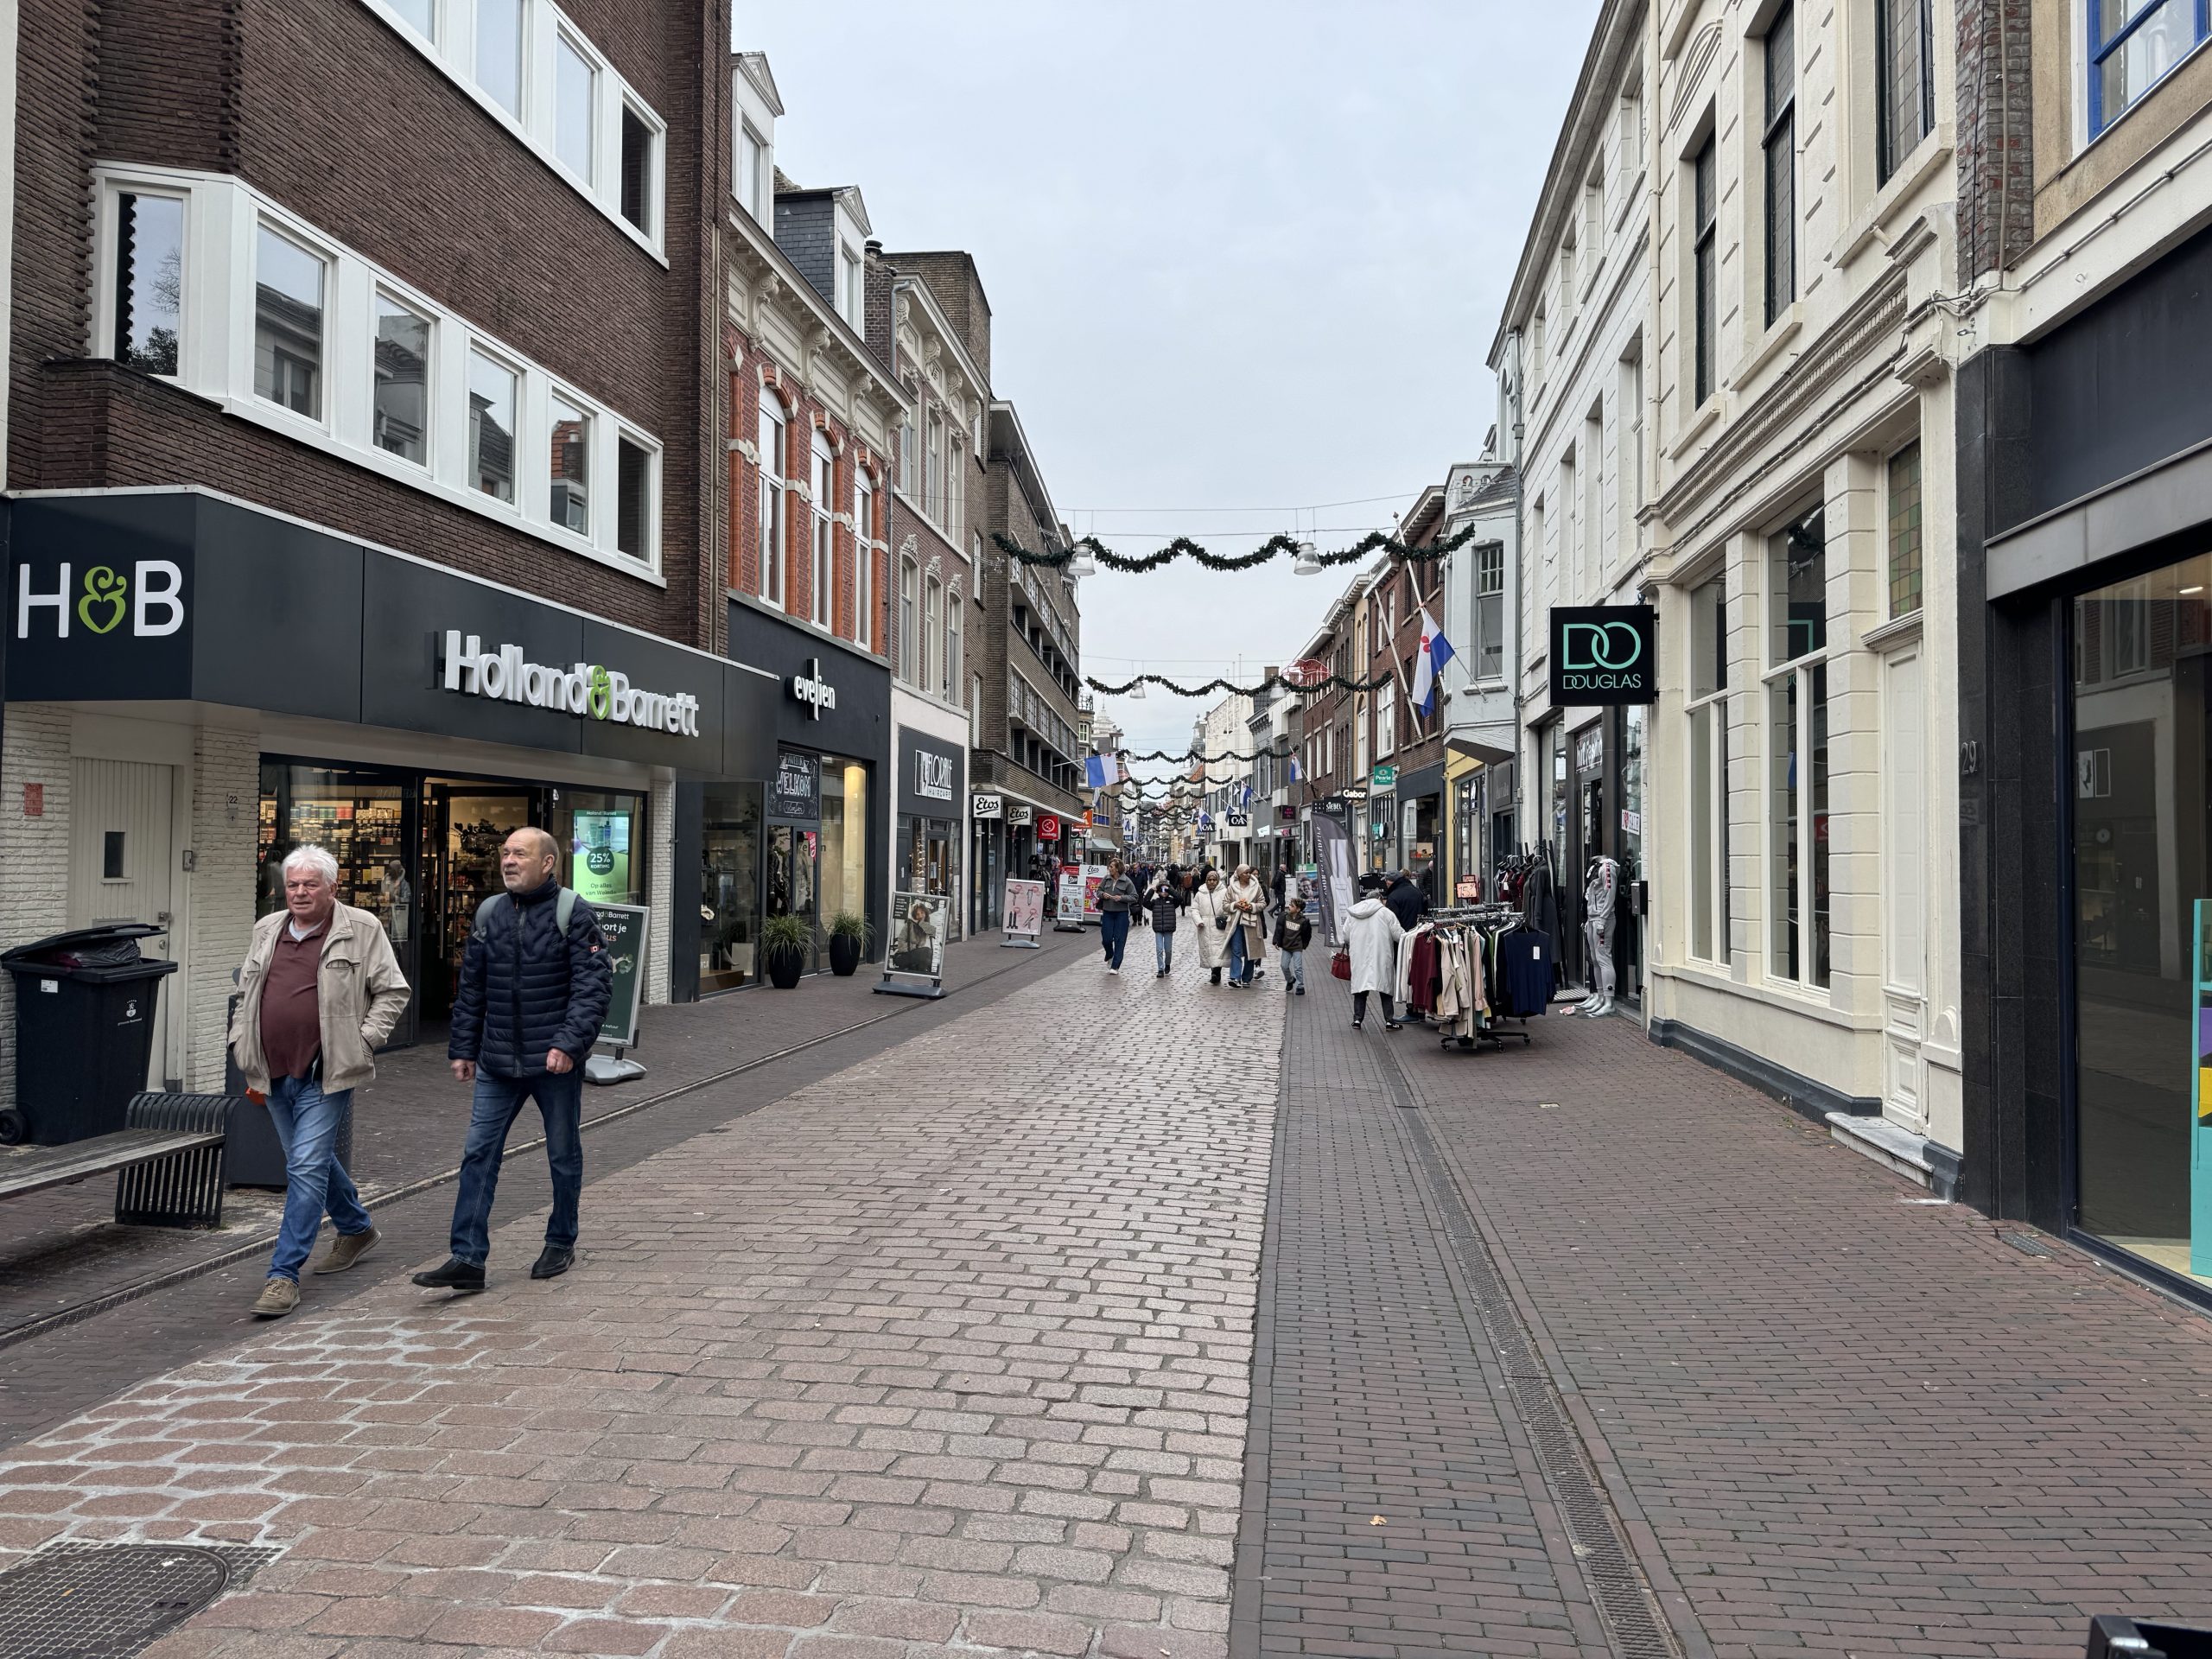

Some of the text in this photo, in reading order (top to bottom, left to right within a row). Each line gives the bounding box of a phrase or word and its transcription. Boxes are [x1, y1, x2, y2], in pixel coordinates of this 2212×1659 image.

[18, 560, 184, 639] H&B
[1562, 673, 1642, 690] DOUGLAS
[793, 658, 836, 721] evelien
[1343, 789, 1366, 798] Gabor
[976, 797, 999, 810] Etos
[1009, 807, 1029, 819] Etos
[590, 853, 611, 863] 25%
[1087, 865, 1099, 874] Etos
[617, 924, 627, 934] je
